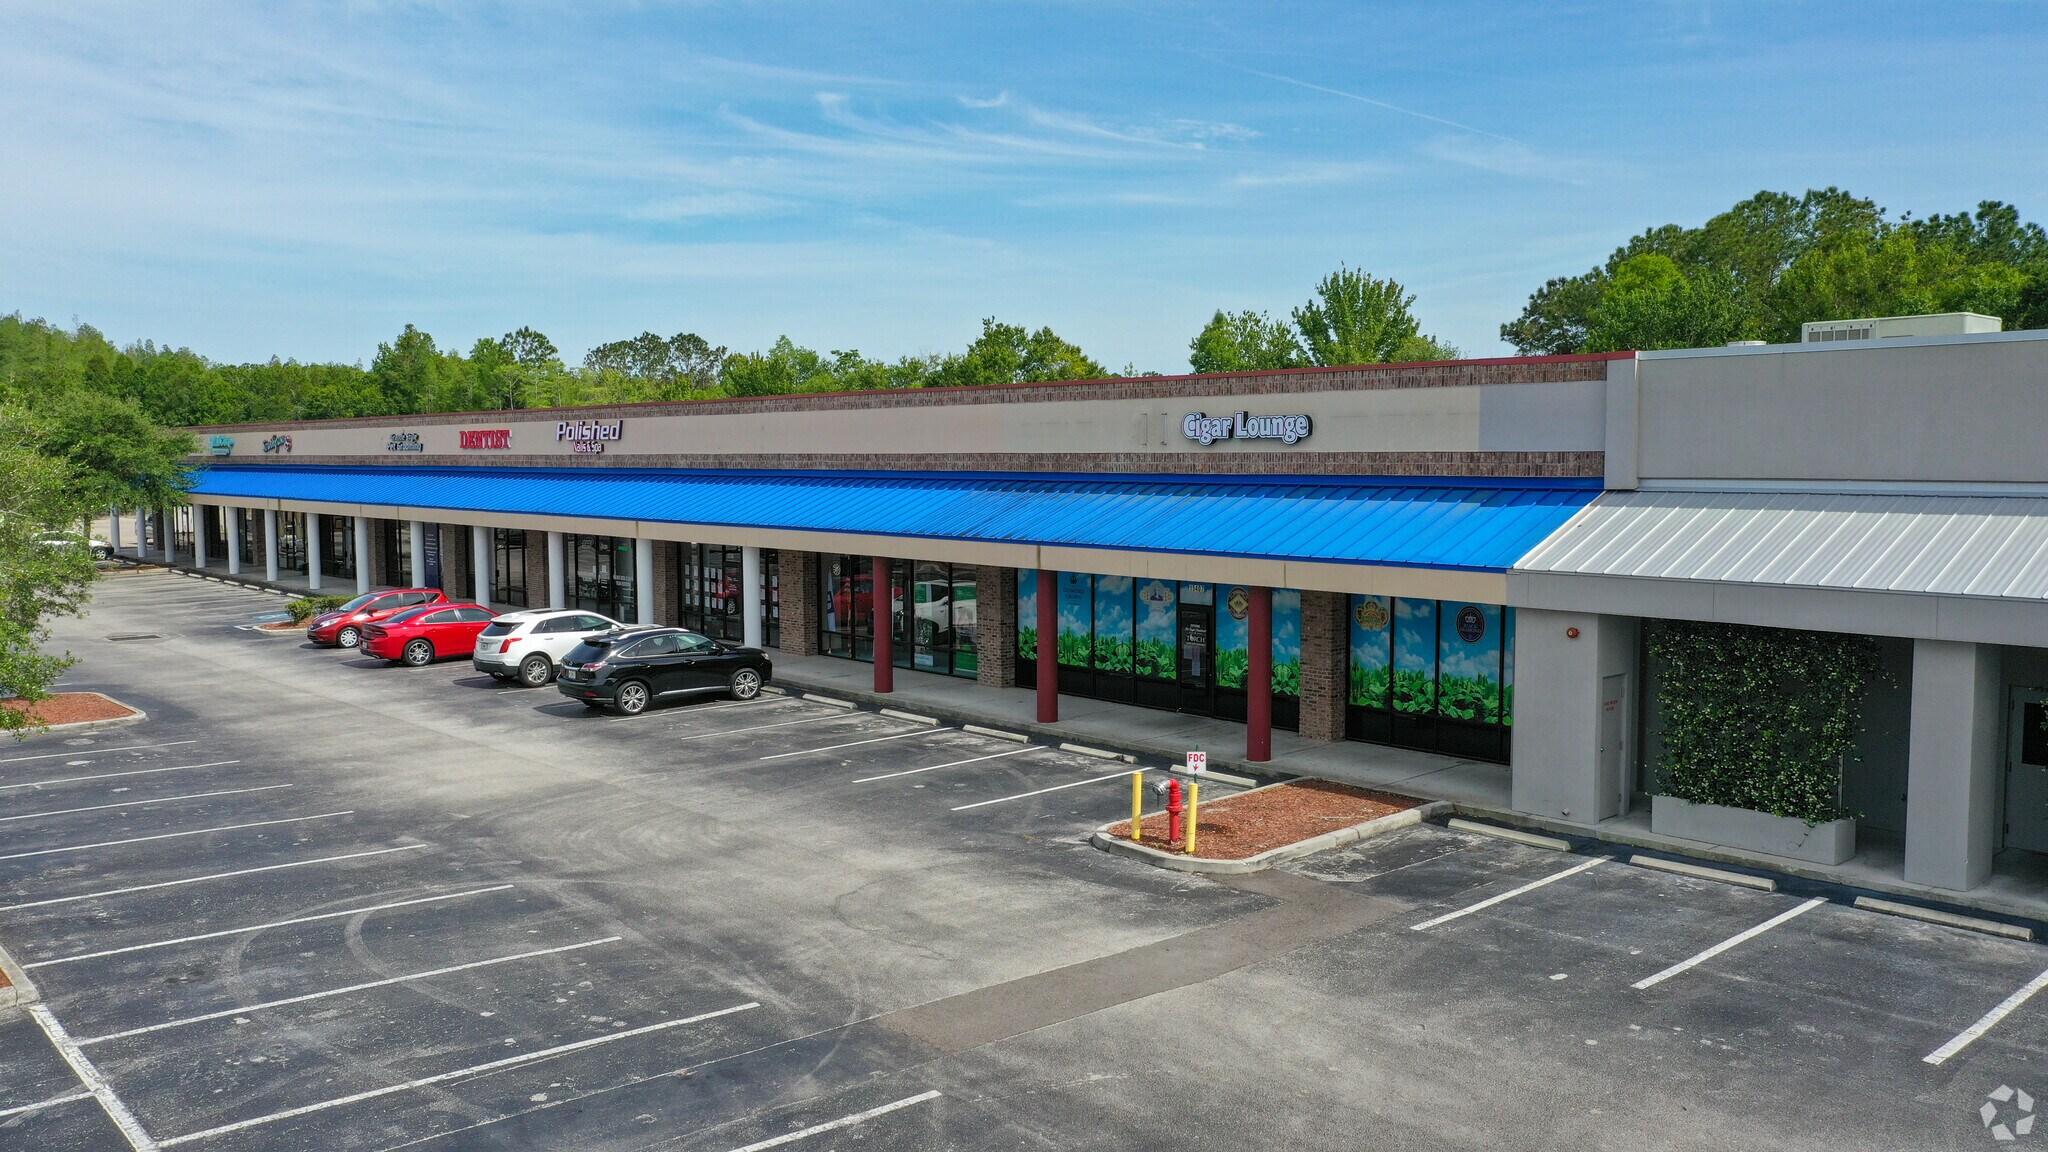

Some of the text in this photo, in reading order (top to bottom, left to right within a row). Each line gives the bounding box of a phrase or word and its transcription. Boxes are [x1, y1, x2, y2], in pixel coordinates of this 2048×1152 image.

[556, 420, 622, 441] Polished
[1182, 411, 1309, 445] Cigar Lounge
[459, 430, 512, 449] DENTIST
[592, 441, 602, 455] Spa
[1188, 753, 1205, 763] FDC
